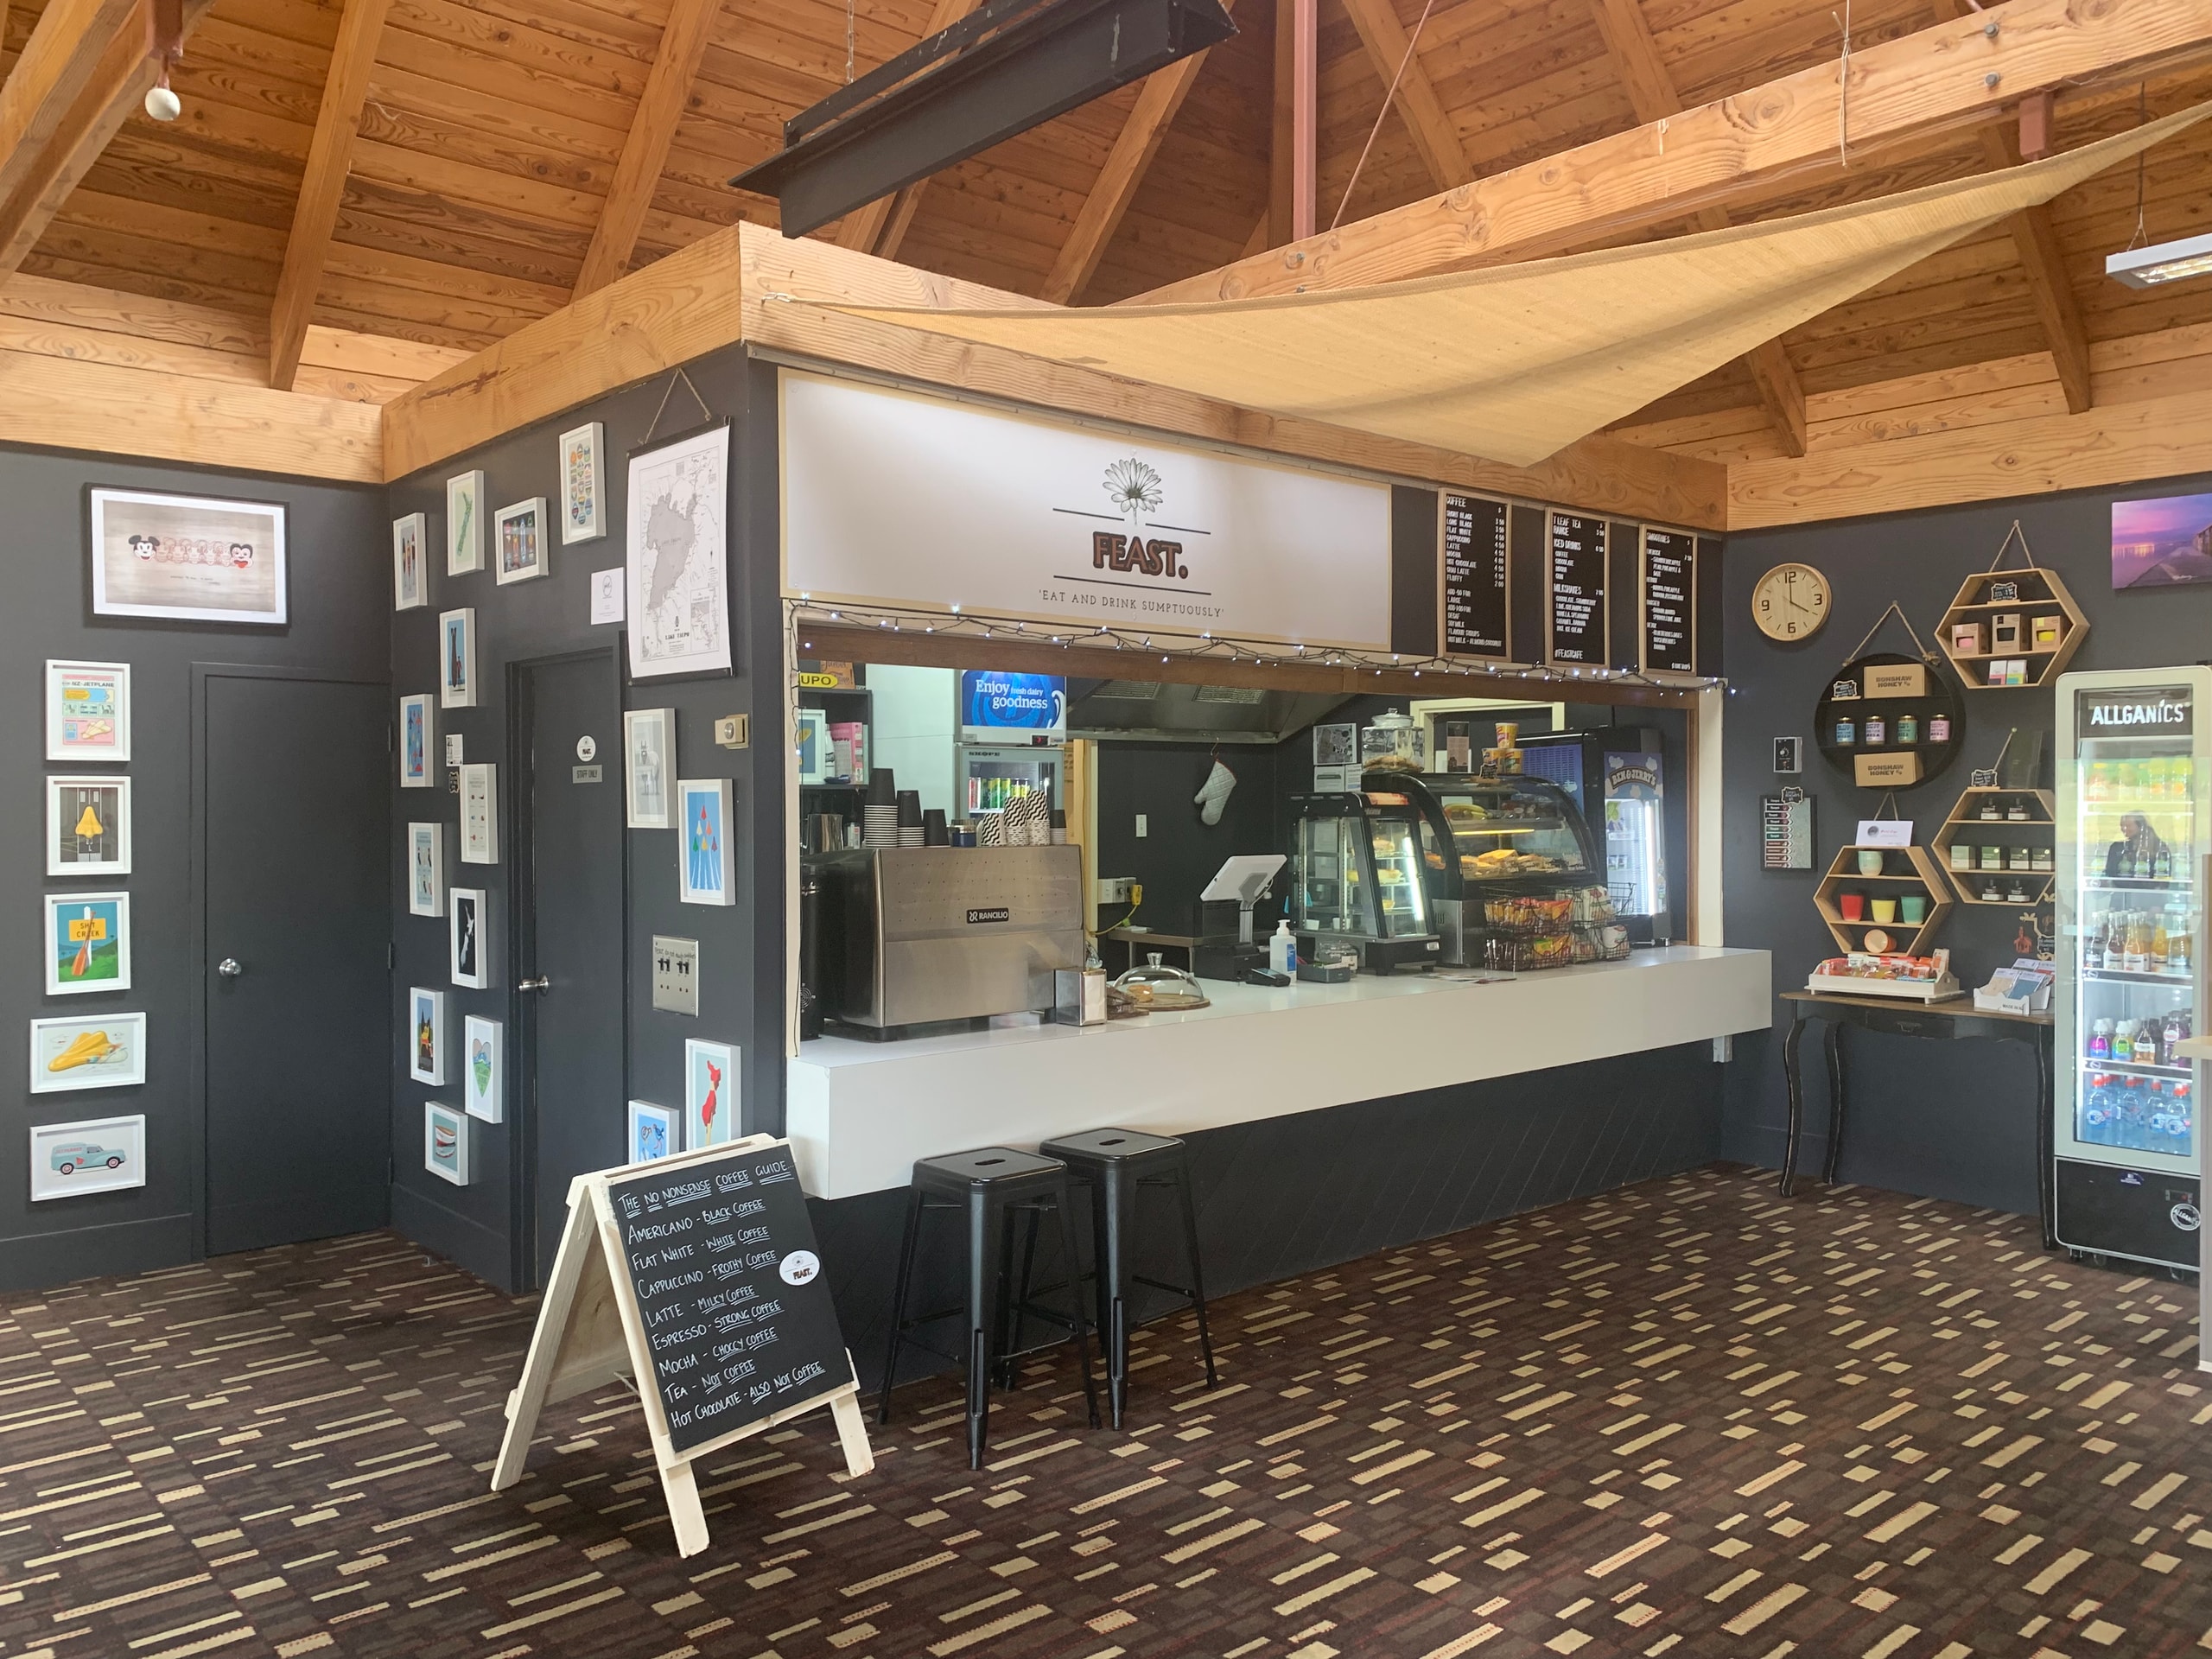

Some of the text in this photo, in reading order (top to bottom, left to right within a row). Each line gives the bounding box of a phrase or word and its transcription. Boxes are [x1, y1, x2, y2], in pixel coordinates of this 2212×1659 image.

[1459, 512, 1472, 520] BLACK
[1459, 519, 1472, 528] BLACK
[1557, 517, 1569, 526] LEAF
[1573, 518, 1581, 529] TEA
[1446, 525, 1457, 534] FLAT
[1446, 542, 1460, 550] LATTE
[1093, 531, 1188, 579] FEAST.
[1457, 567, 1470, 575] LATTE
[1785, 571, 1796, 584] 12
[1071, 594, 1097, 606] AND
[1103, 596, 1137, 610] DRINK
[1761, 600, 1770, 612] 9
[1815, 594, 1822, 606] 3
[1788, 622, 1796, 633] 6
[976, 679, 1044, 696] Enjoy fresh dairy
[992, 695, 1048, 709] goodness
[618, 1192, 640, 1211] THE
[645, 1192, 659, 1205] NO
[662, 1179, 710, 1200] NONSENSE
[715, 1170, 749, 1187] COFFEE
[628, 1217, 692, 1244] AMERICANO
[702, 1206, 731, 1223] BLACK
[733, 1198, 764, 1214] COFFEE
[632, 1253, 657, 1271] FLAT
[661, 1244, 694, 1262] WHITE
[706, 1234, 735, 1249] WHITE
[738, 1226, 768, 1242] COFFEE
[638, 1270, 703, 1299] CAPPUCCINO
[712, 1258, 743, 1276] FROTHY
[747, 1250, 776, 1265] COFFEE
[645, 1303, 683, 1327] LATTE
[697, 1293, 725, 1310] MILKY
[726, 1285, 755, 1302] COFFEE
[652, 1324, 707, 1351] ESPRESSO
[715, 1309, 750, 1328] STRONG
[751, 1300, 781, 1318] COFFEE
[659, 1353, 698, 1377] MOCHA
[713, 1338, 744, 1357] CHOCCY
[746, 1327, 776, 1345] COFFEE
[664, 1382, 688, 1403] TEA
[702, 1372, 720, 1388] NOT
[724, 1359, 755, 1380] COFFEE
[671, 1410, 691, 1428] HOT
[695, 1391, 741, 1420] CHOCOLATE
[750, 1382, 770, 1398] ALSO
[774, 1373, 791, 1389] NOT
[791, 1361, 824, 1381] COFFEE
